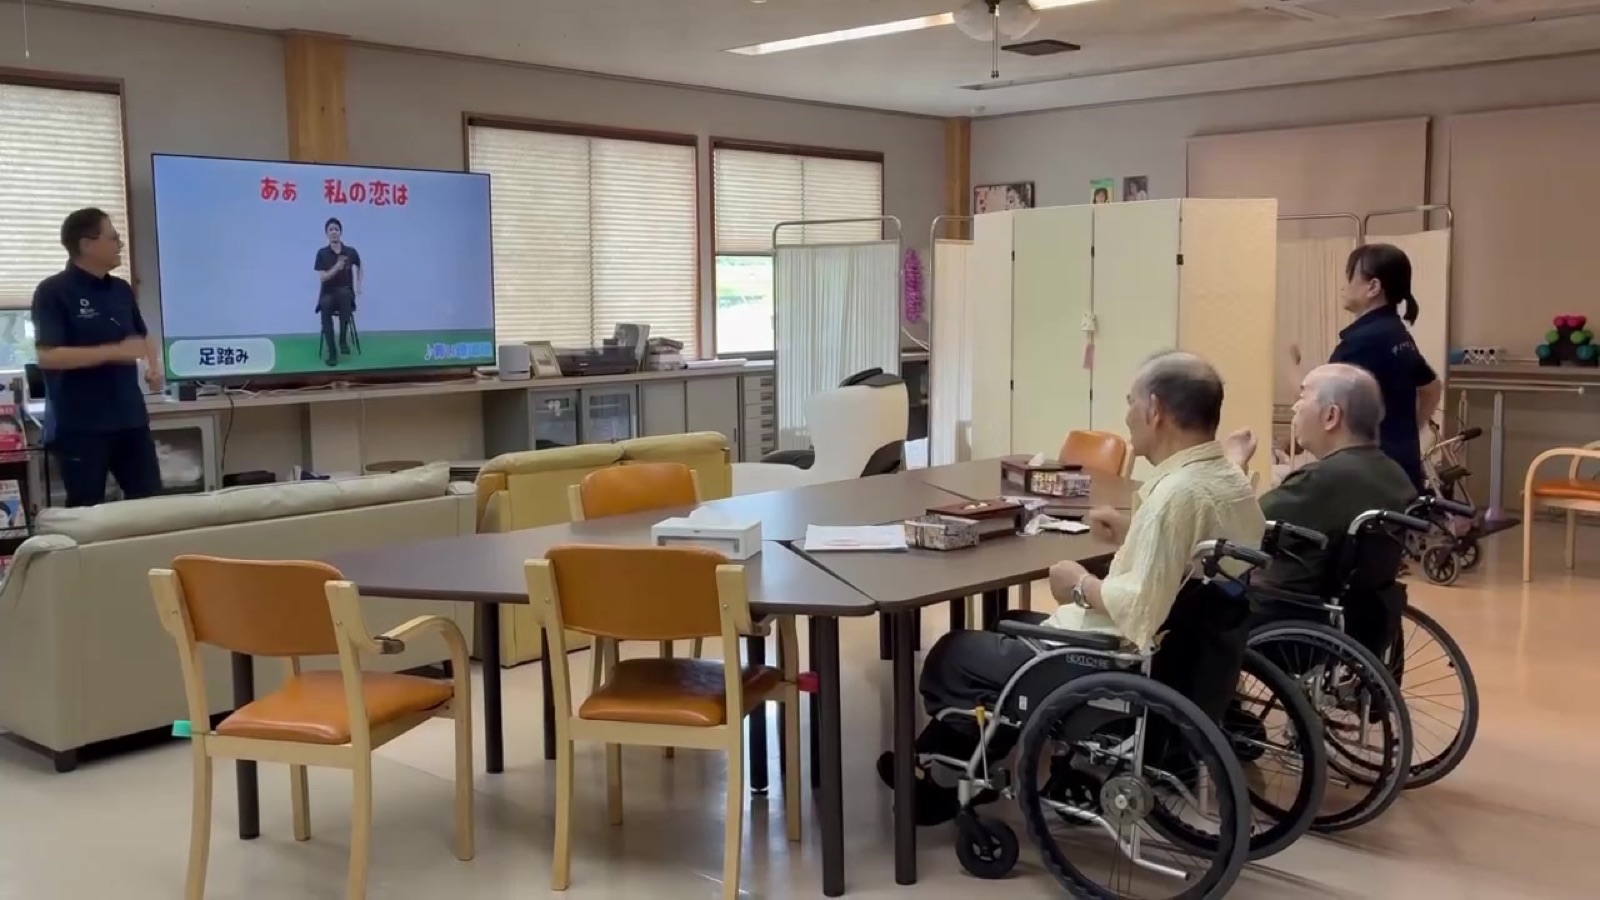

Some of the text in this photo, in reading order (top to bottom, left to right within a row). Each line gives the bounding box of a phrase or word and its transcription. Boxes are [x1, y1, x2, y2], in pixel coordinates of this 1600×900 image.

[324, 178, 409, 206] 私の恋は
[199, 346, 249, 366] 足踏み
